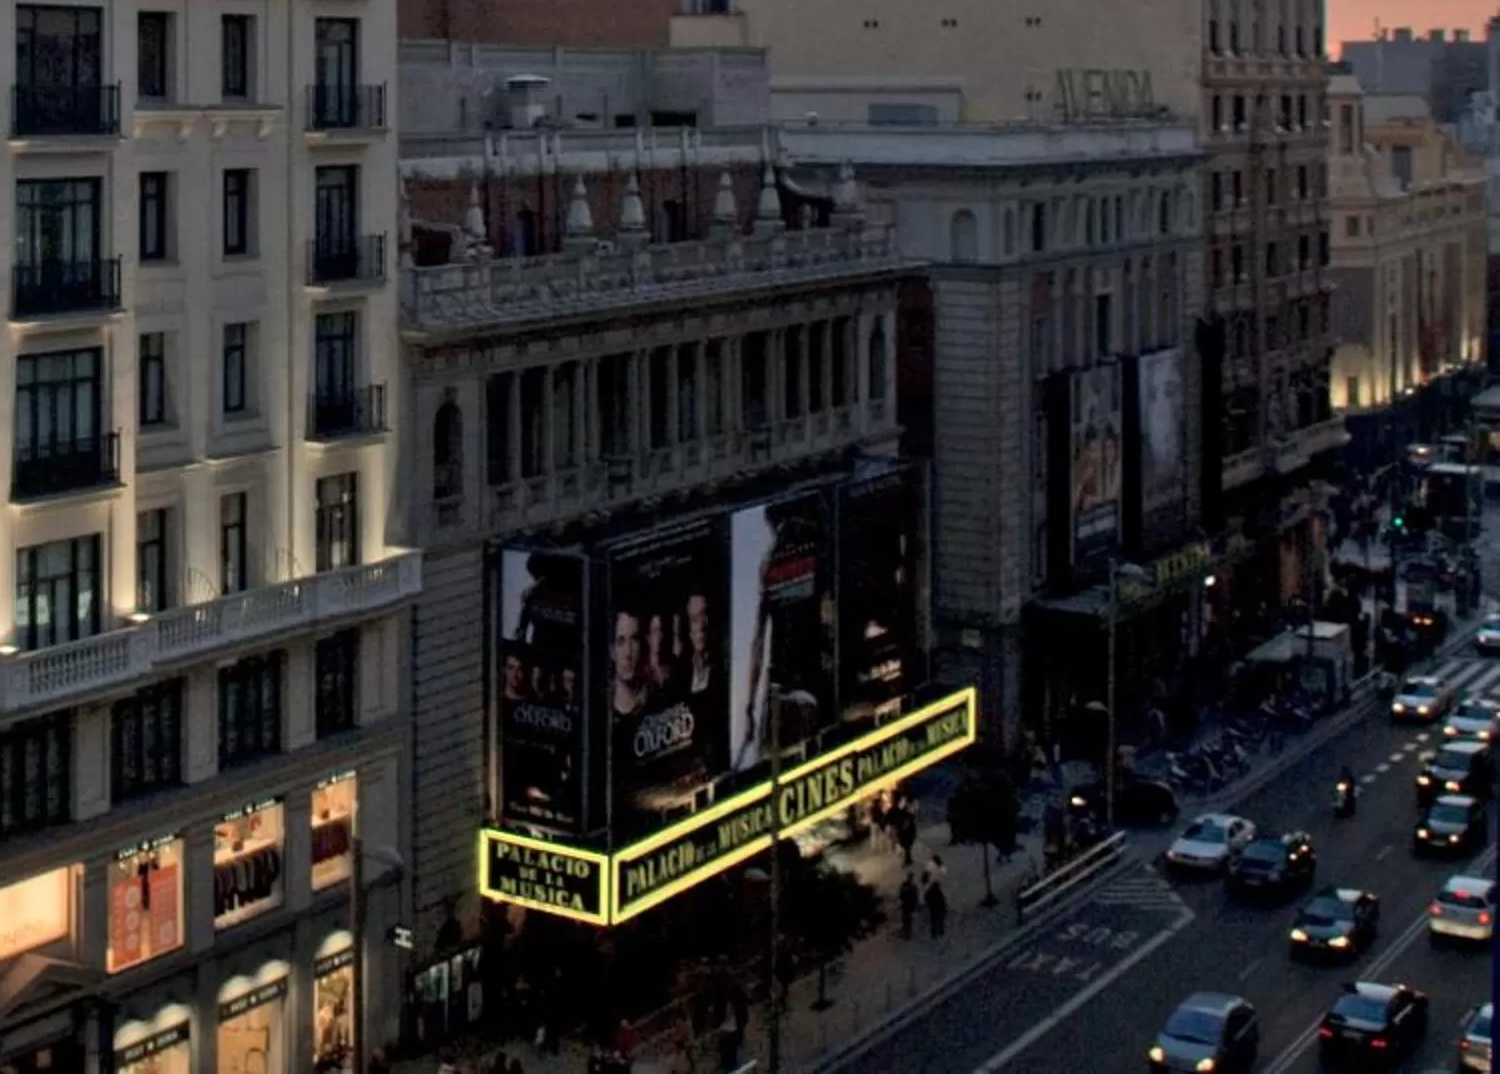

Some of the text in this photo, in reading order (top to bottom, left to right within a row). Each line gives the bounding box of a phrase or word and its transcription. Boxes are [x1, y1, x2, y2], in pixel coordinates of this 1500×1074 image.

[627, 841, 695, 897] PALACIO
[718, 804, 772, 849] MUSICA
[779, 756, 855, 825] CINES
[858, 737, 910, 782] PALACIO
[497, 841, 590, 879] PALACIO
[519, 866, 564, 887] DE LA
[500, 876, 584, 911] MUSICA
